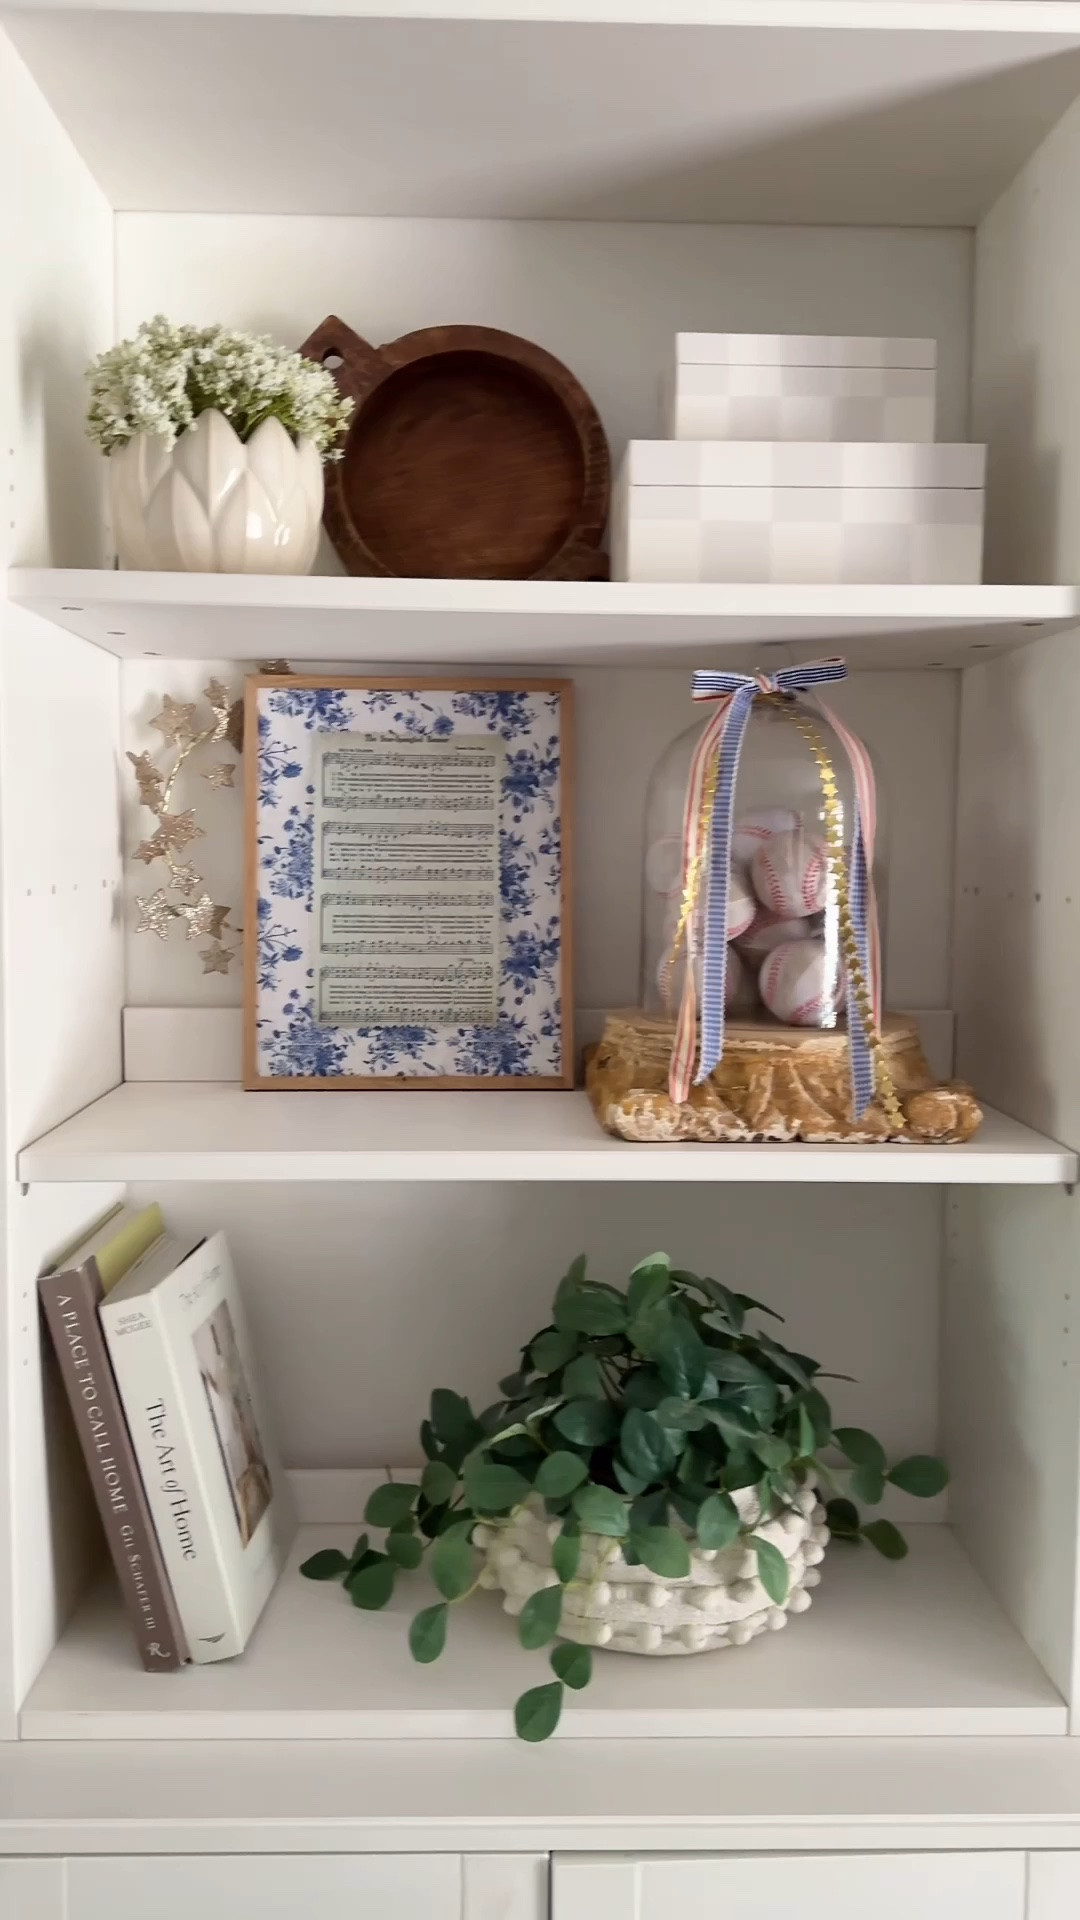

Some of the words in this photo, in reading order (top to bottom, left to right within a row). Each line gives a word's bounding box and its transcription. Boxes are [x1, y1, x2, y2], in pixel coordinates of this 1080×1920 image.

[56, 1295, 72, 1307] A
[62, 1311, 90, 1369] PLACE
[79, 1372, 98, 1400] TO
[87, 1406, 111, 1453] CALL
[146, 1398, 166, 1439] The
[155, 1445, 176, 1475] Art
[100, 1457, 128, 1514] HOME
[160, 1480, 187, 1494] of
[170, 1499, 196, 1561] Home
